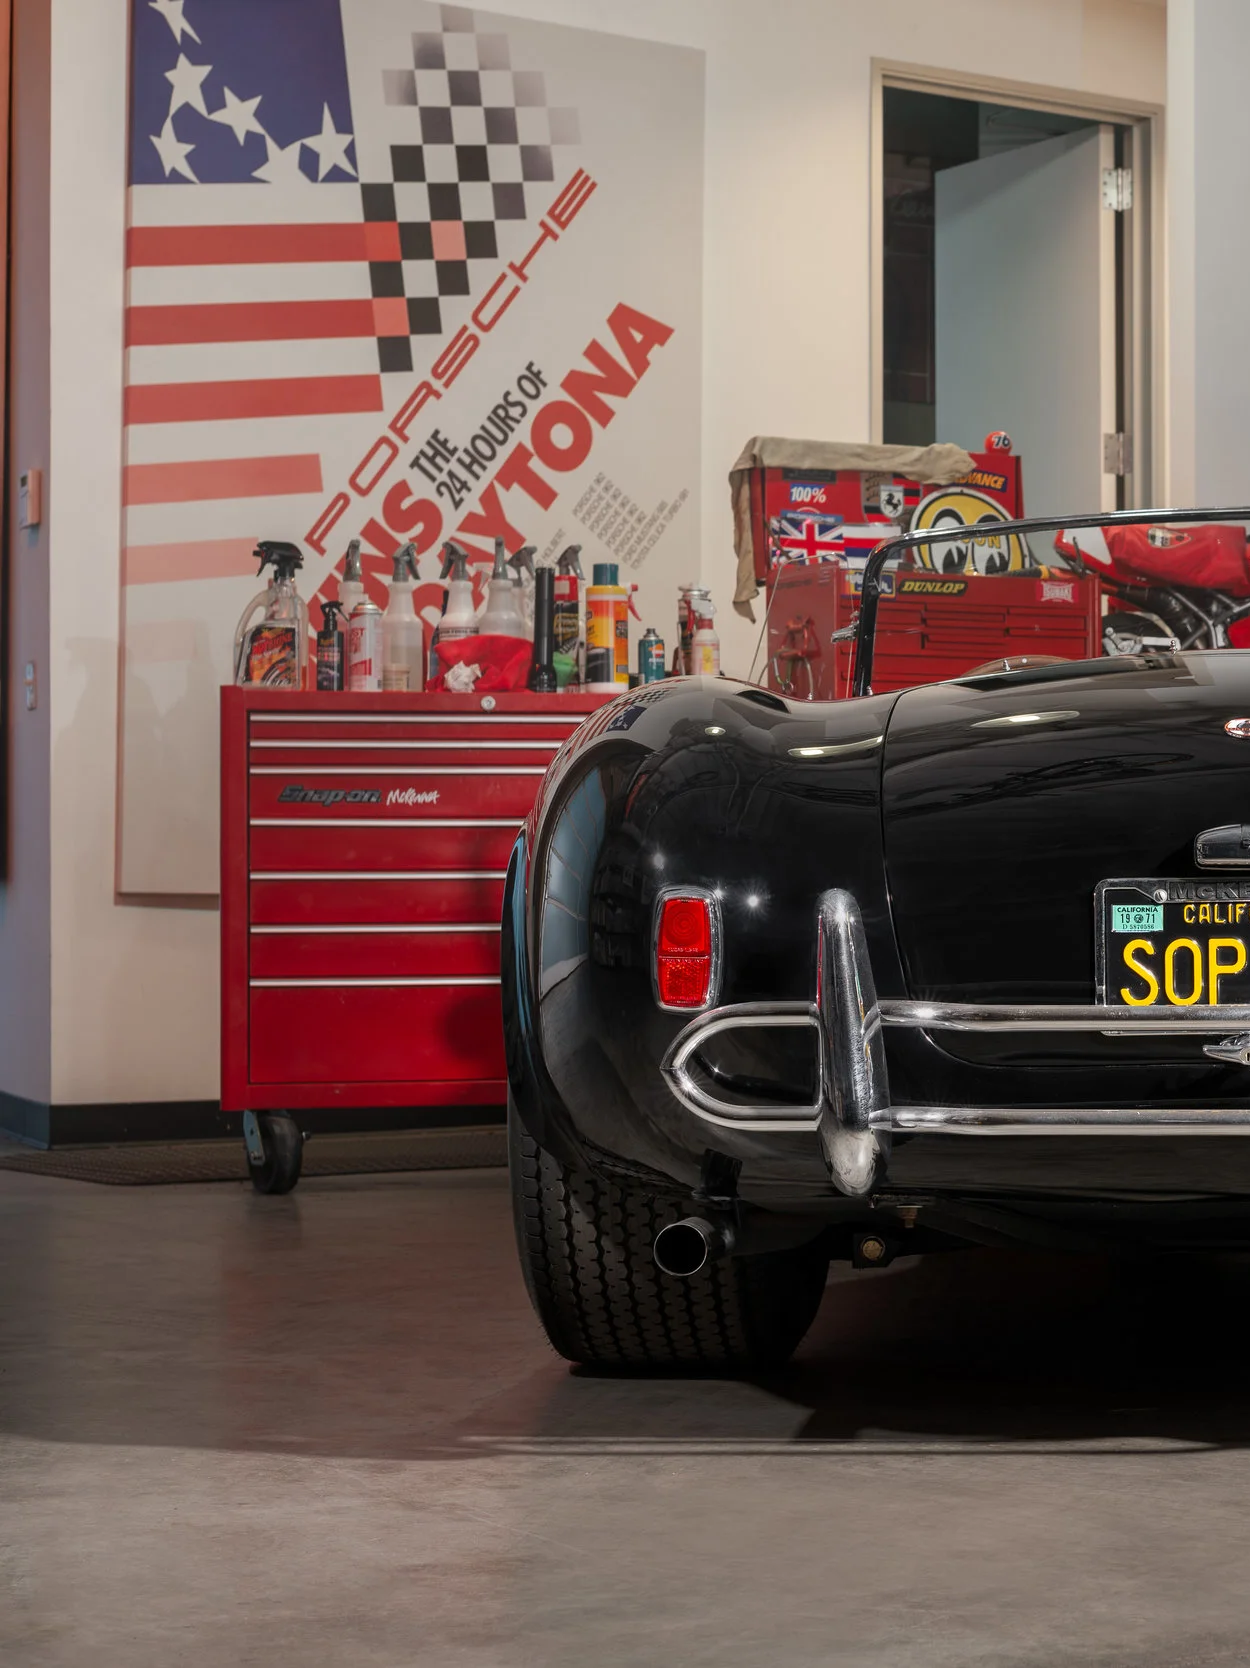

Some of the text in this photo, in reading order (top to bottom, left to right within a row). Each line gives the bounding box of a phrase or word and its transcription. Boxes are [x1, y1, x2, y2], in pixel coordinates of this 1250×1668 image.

[303, 167, 598, 557] PORSCHE
[435, 360, 549, 512] 24 HOURS OF
[992, 435, 1010, 448] 76
[409, 428, 460, 483] THE
[791, 487, 827, 503] 100%
[902, 580, 965, 593] DUNLOP
[278, 784, 381, 807] Snap-on
[1120, 914, 1155, 923] 19 71
[1120, 937, 1248, 1006] SOP
